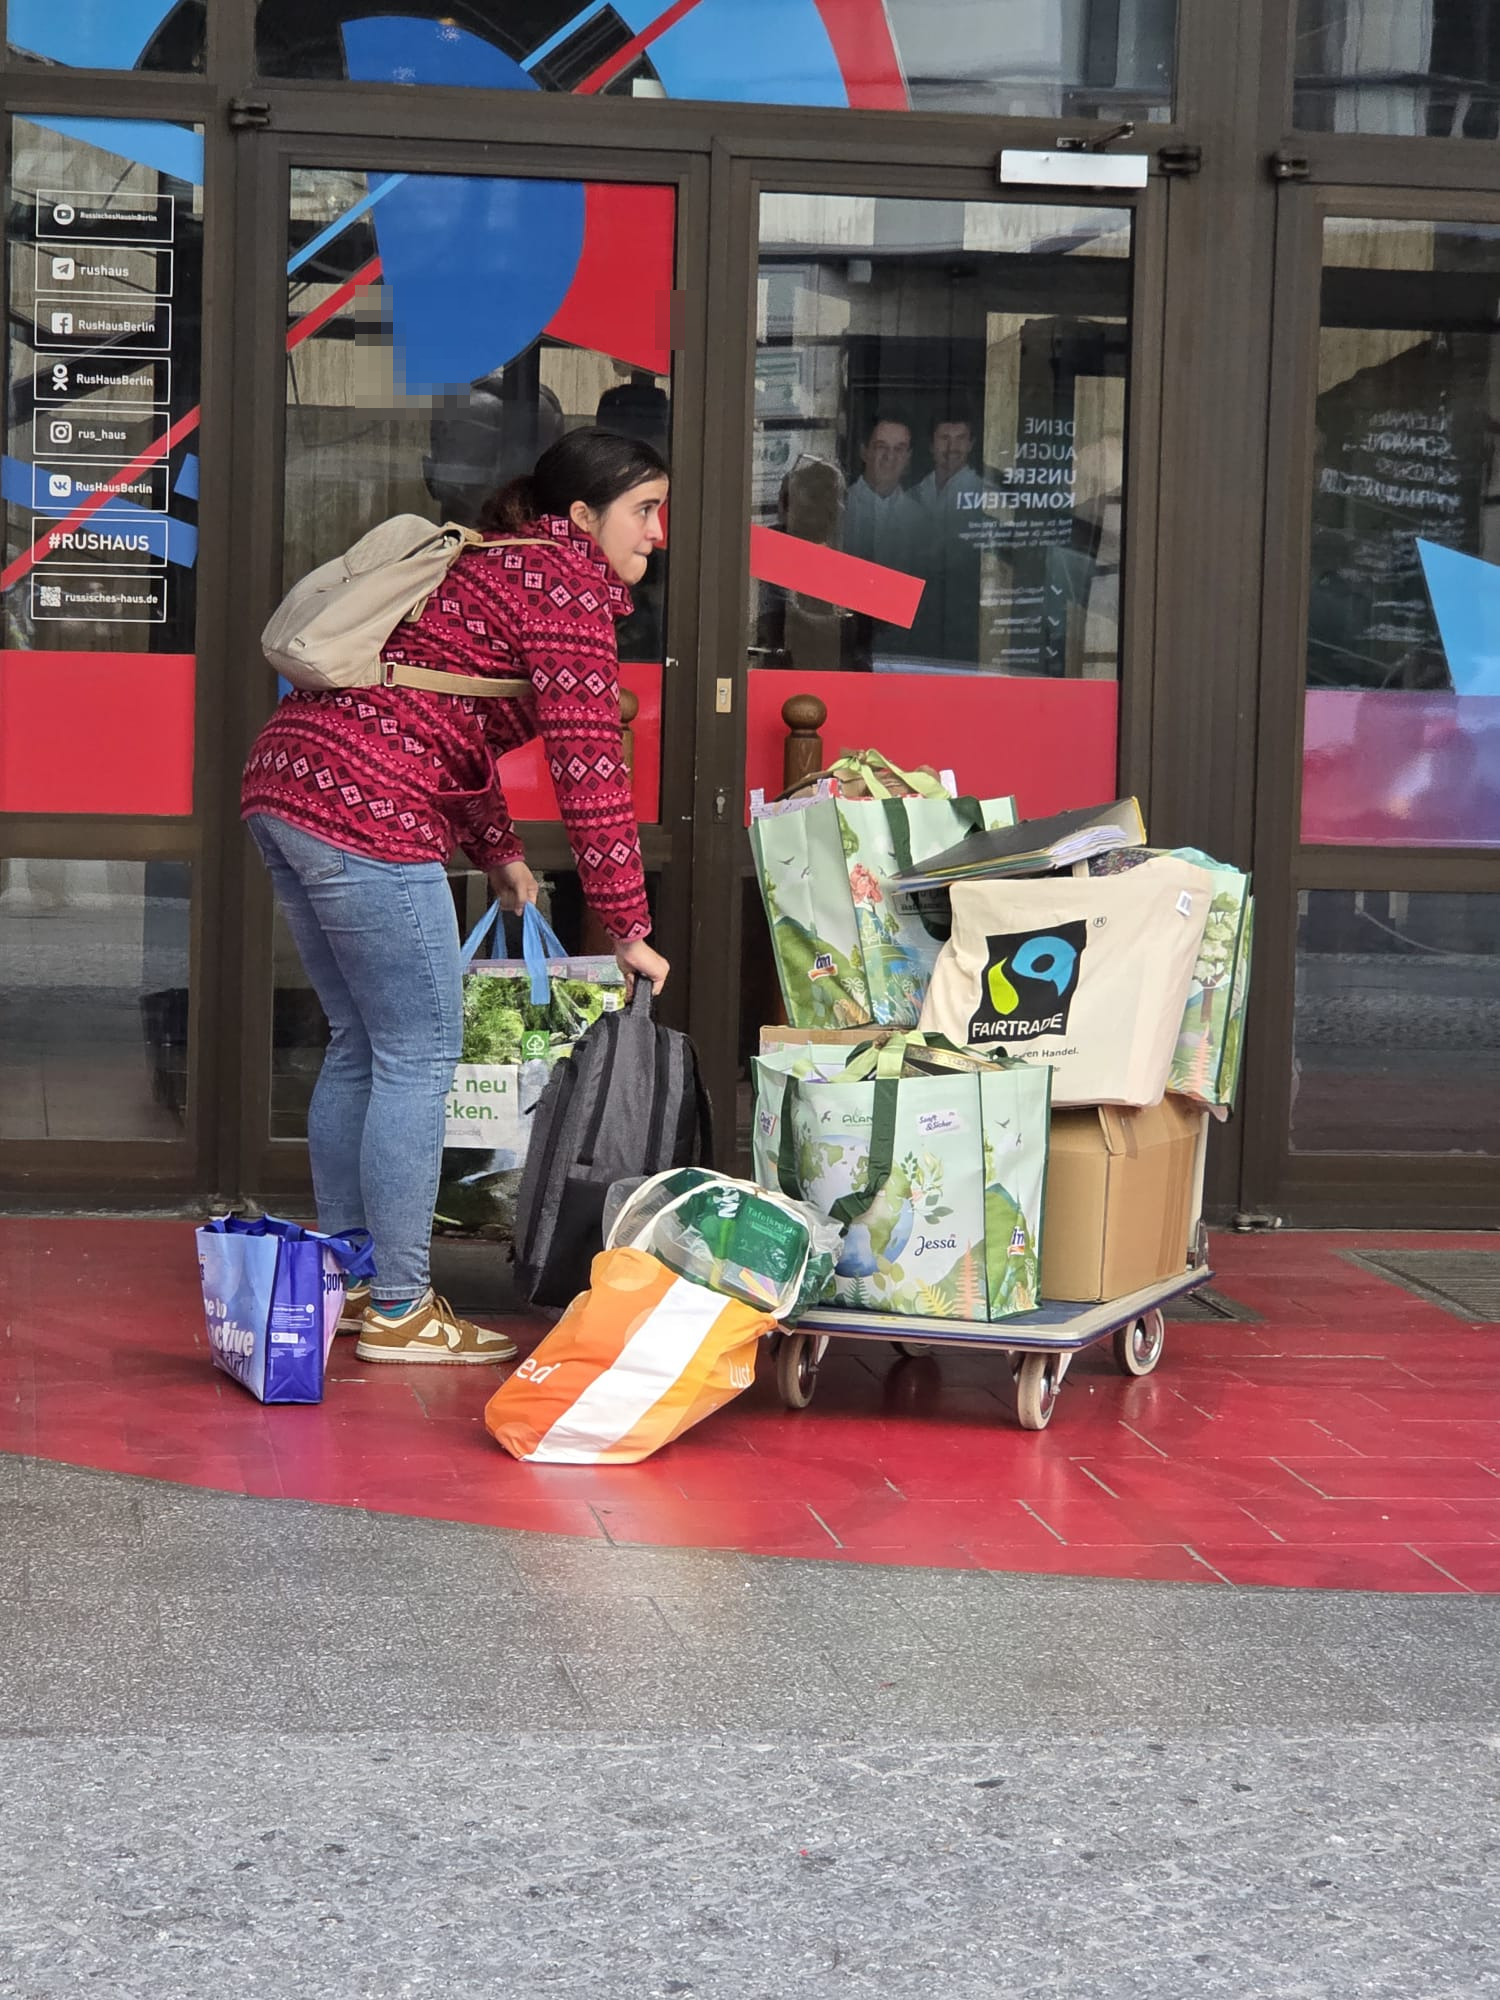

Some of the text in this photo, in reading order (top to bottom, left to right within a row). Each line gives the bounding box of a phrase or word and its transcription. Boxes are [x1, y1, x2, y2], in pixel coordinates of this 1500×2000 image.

[80, 264, 129, 276] rushaus
[78, 319, 156, 333] RusHausBerlin
[76, 373, 153, 387] RusHausBerlin
[78, 429, 127, 440] rus_haus
[75, 481, 153, 494] RusHausBerlin
[48, 533, 150, 551] #RUSHAUS
[65, 594, 159, 605] russisches-haus.de
[972, 1012, 1064, 1038] FAIRTRADE
[1041, 1047, 1080, 1058] Handel.
[466, 1079, 507, 1093] neu
